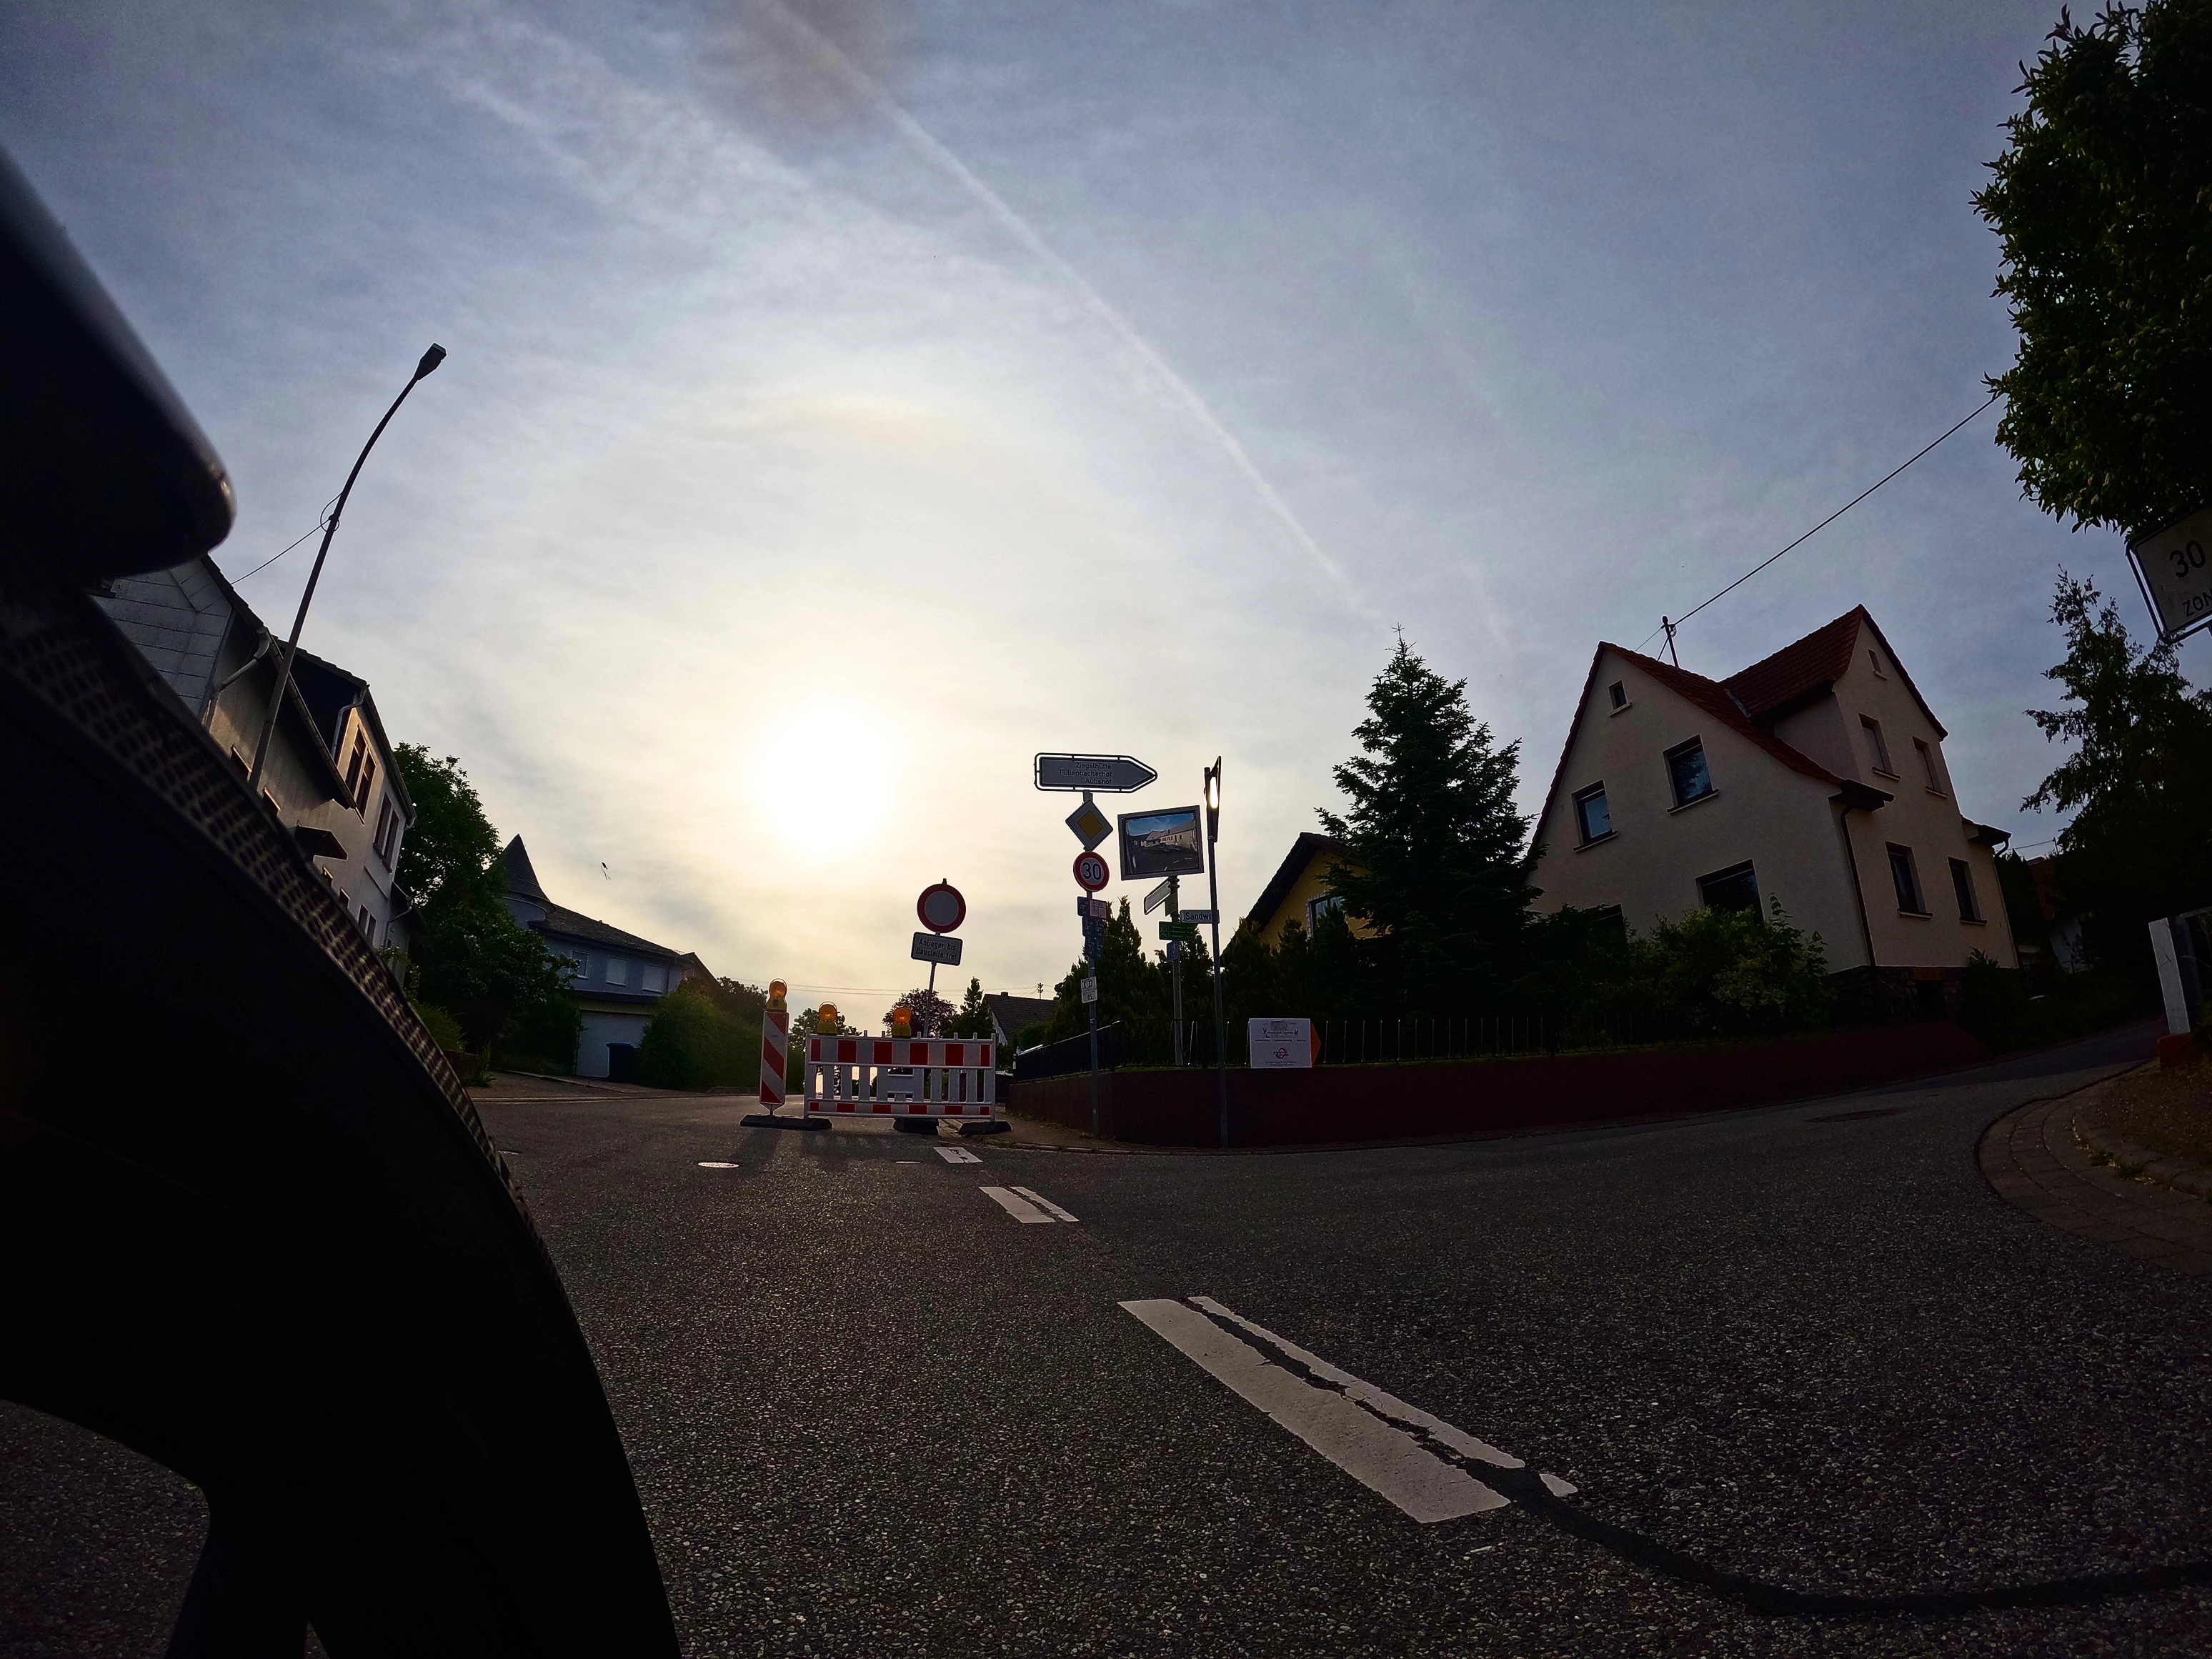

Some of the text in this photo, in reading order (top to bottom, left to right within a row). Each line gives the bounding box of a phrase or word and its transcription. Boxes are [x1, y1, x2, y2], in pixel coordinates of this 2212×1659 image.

[2169, 540, 2206, 578] 30
[2182, 588, 2212, 617] ZON
[1059, 769, 1112, 777] Füllenbacherhof
[1082, 862, 1101, 880] 30
[1185, 911, 1212, 921] Sandwe
[919, 938, 945, 950] Anlieger
[916, 947, 957, 960] Baustelle frei
